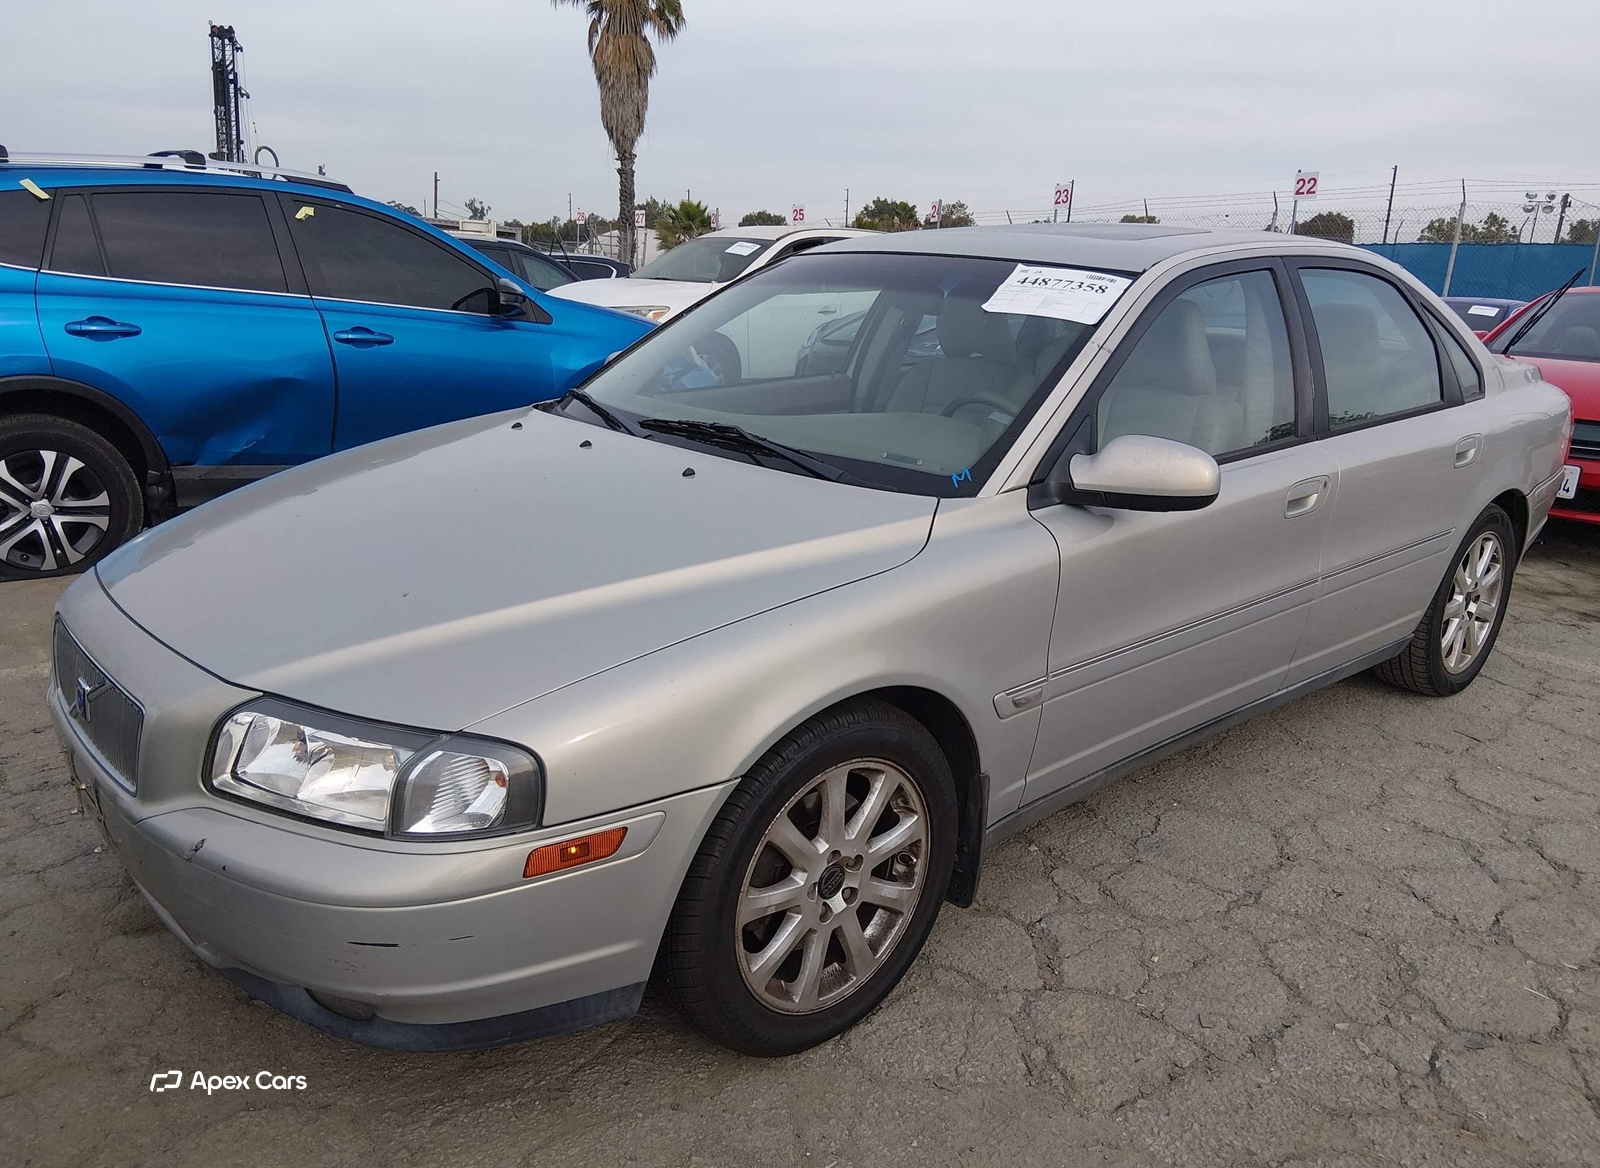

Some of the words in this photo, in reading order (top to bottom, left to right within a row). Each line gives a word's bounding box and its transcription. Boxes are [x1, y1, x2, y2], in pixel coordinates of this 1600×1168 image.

[1295, 177, 1317, 195] 22
[1054, 189, 1069, 205] 23
[577, 211, 585, 221] 28
[635, 213, 645, 223] 27
[792, 208, 805, 221] 25
[1016, 276, 1109, 294] 44877358
[951, 467, 972, 488] M
